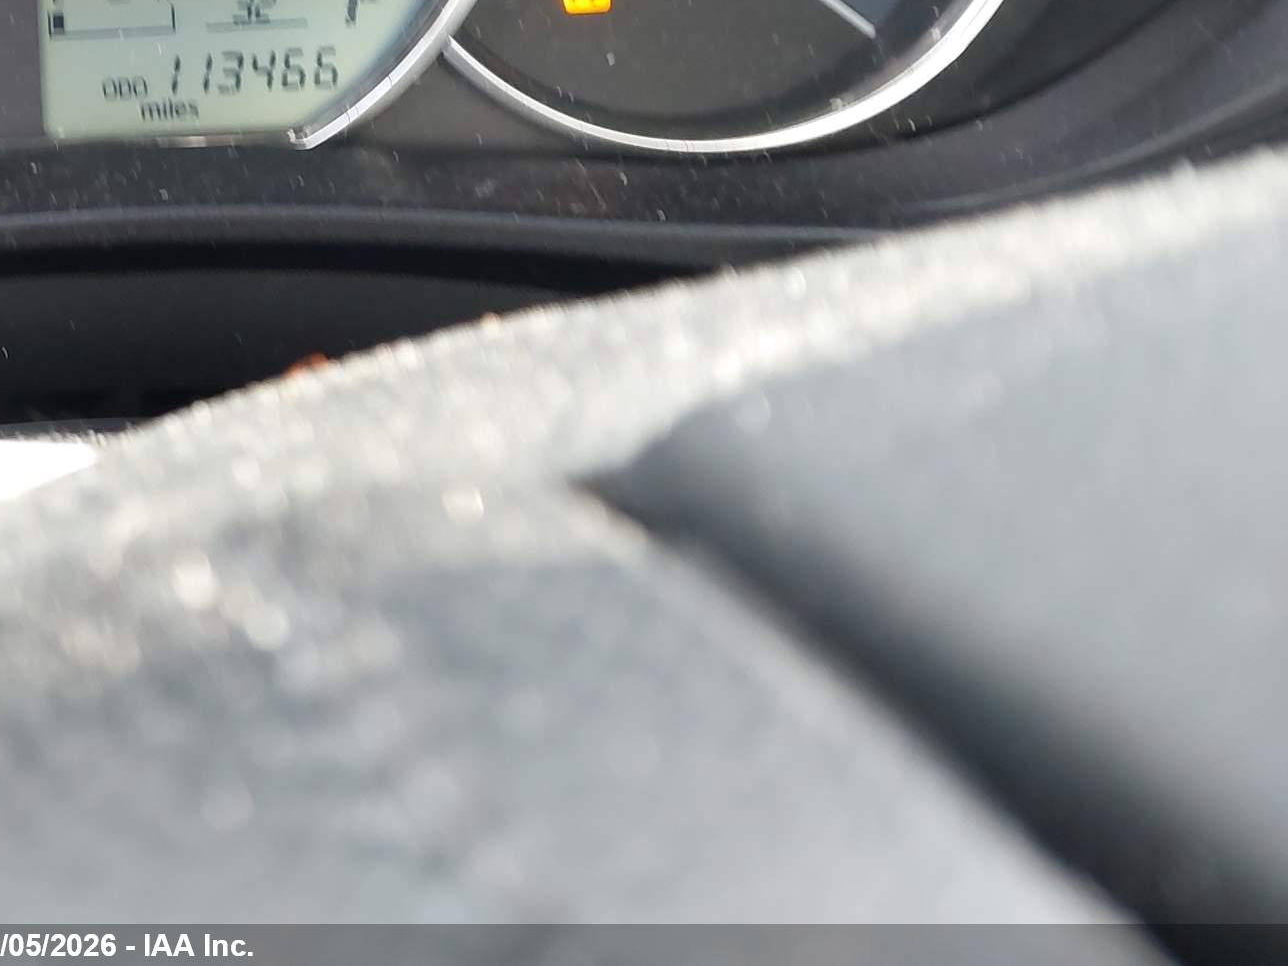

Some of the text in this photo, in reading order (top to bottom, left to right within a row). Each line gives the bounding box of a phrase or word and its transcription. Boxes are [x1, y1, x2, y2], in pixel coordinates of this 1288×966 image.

[102, 45, 339, 102] ODO 113466
[140, 98, 201, 123] miles
